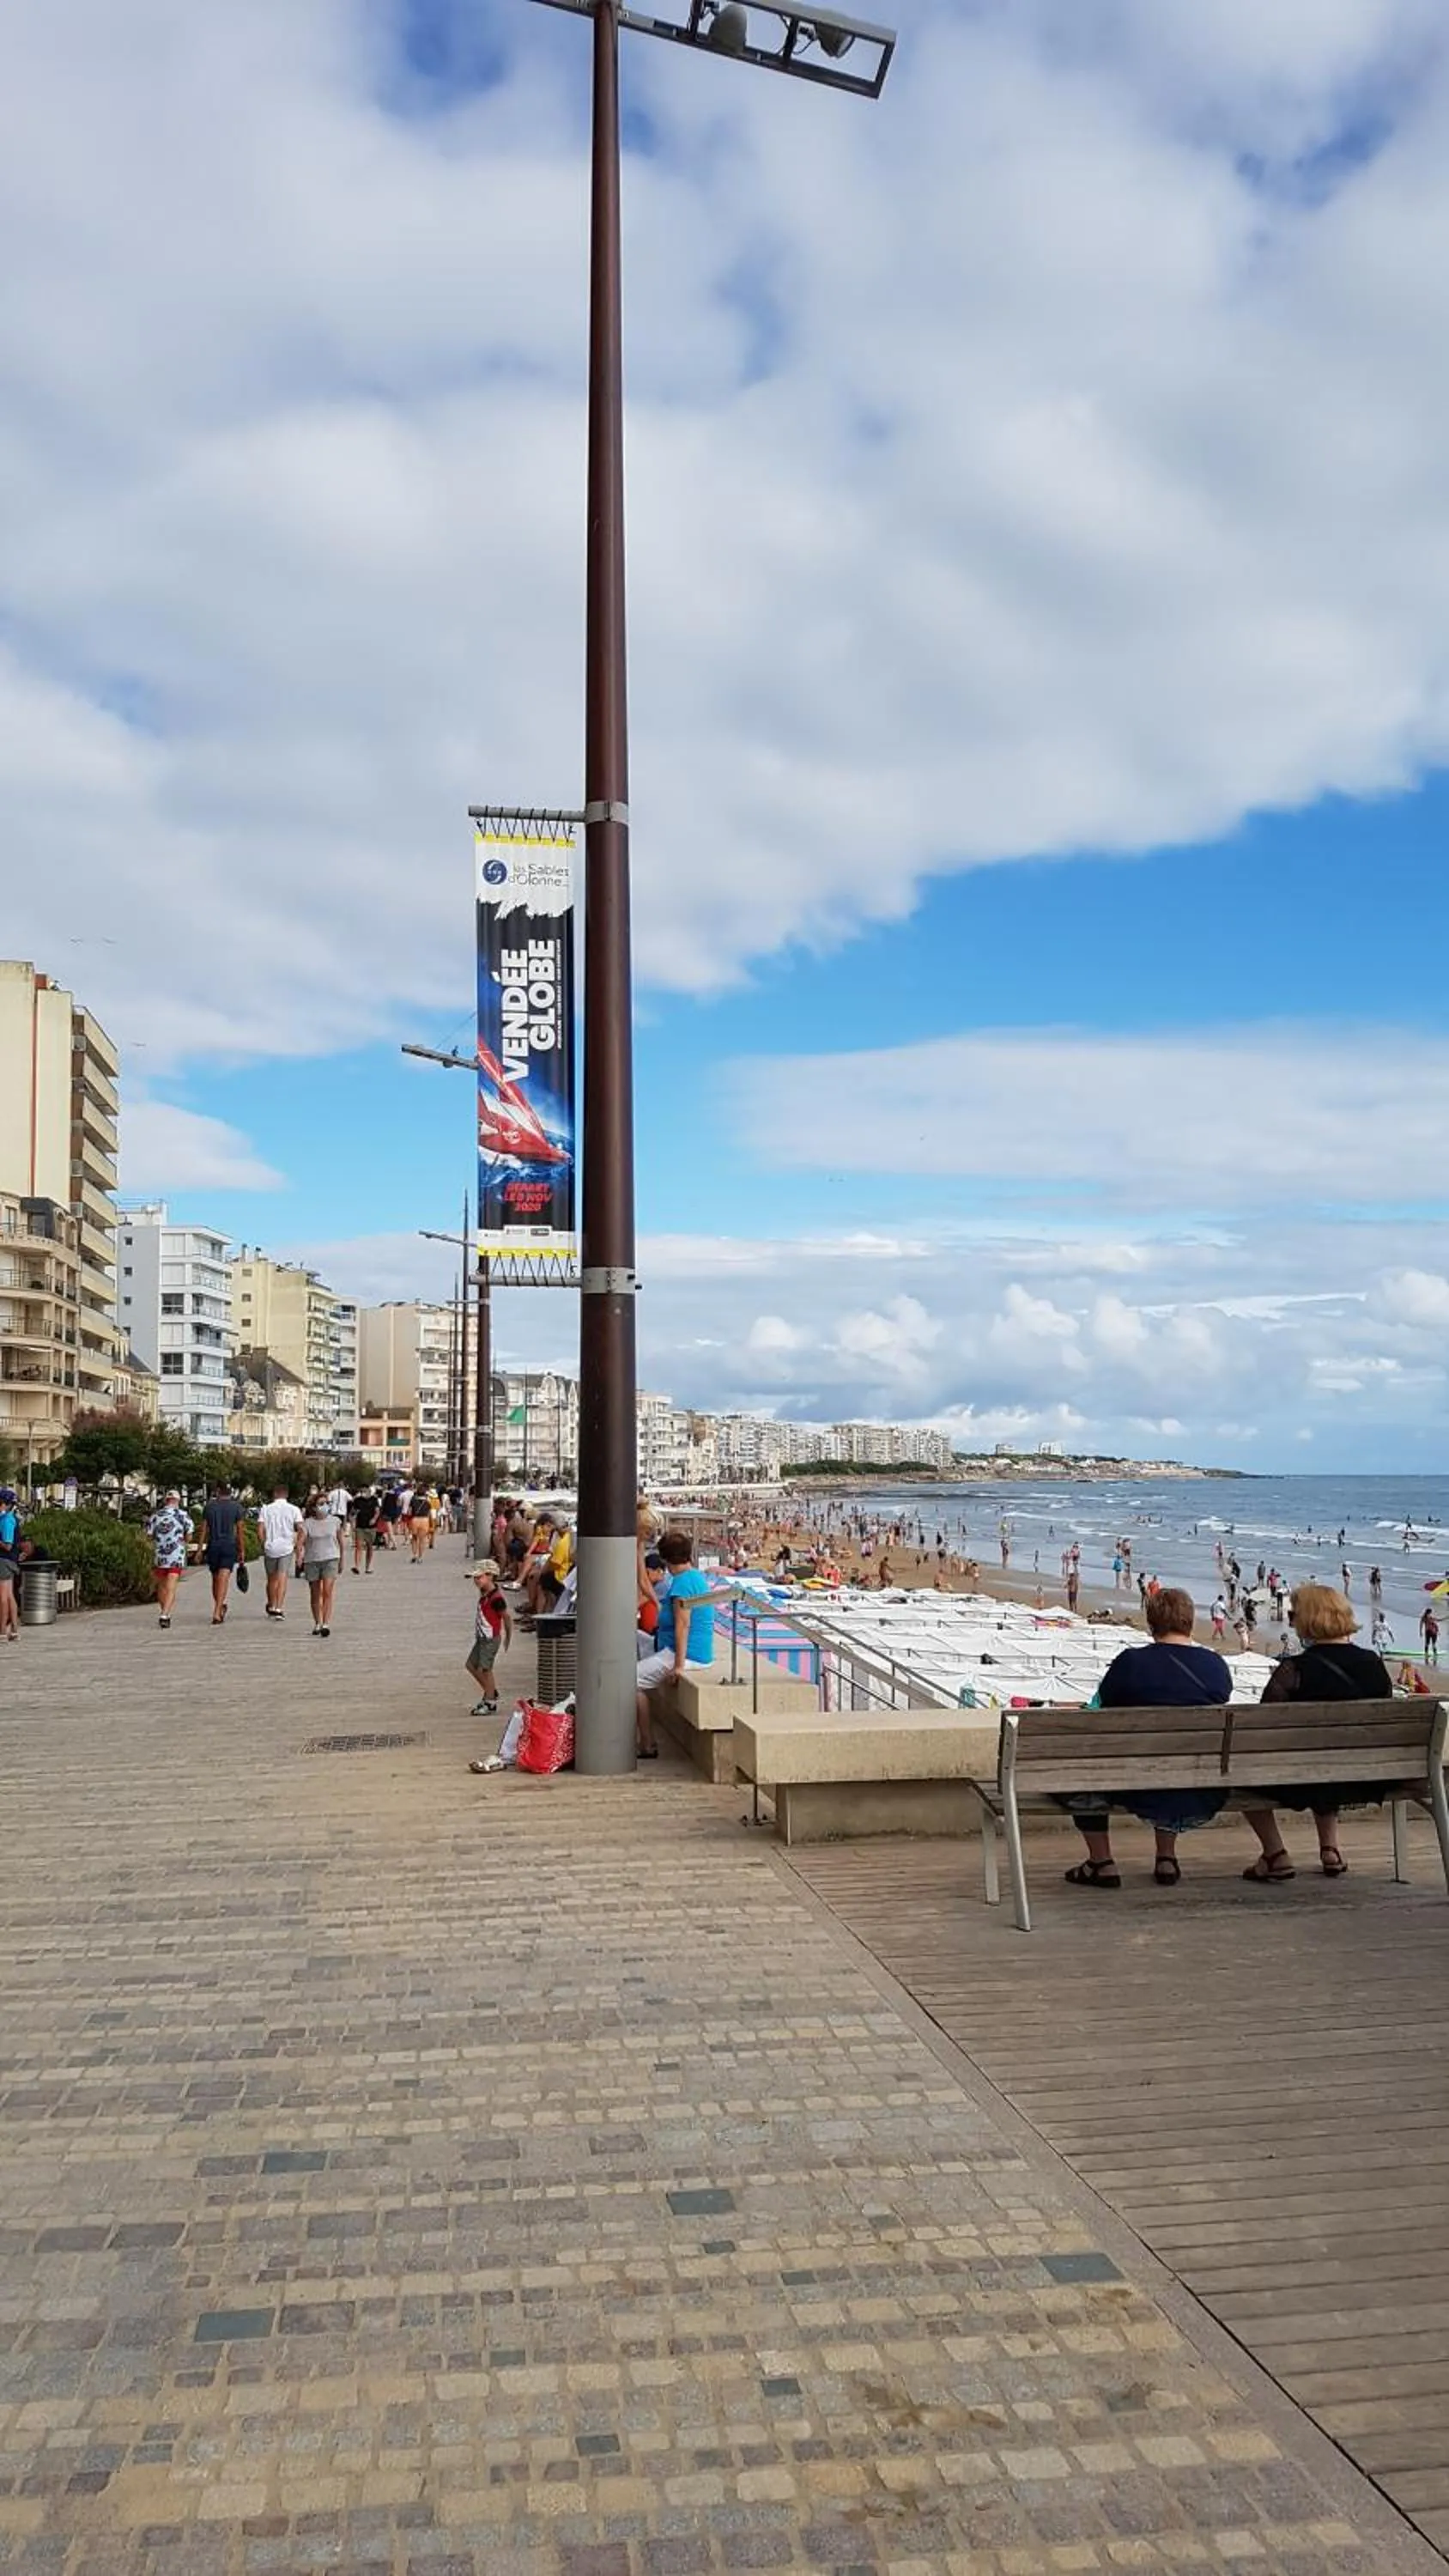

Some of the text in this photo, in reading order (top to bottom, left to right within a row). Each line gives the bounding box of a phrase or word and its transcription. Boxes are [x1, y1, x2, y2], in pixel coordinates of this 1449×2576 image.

[508, 872, 561, 886] d'Olonne
[528, 864, 569, 876] Sables
[492, 950, 528, 1080] VENDÉE
[529, 939, 555, 1050] GLOBE
